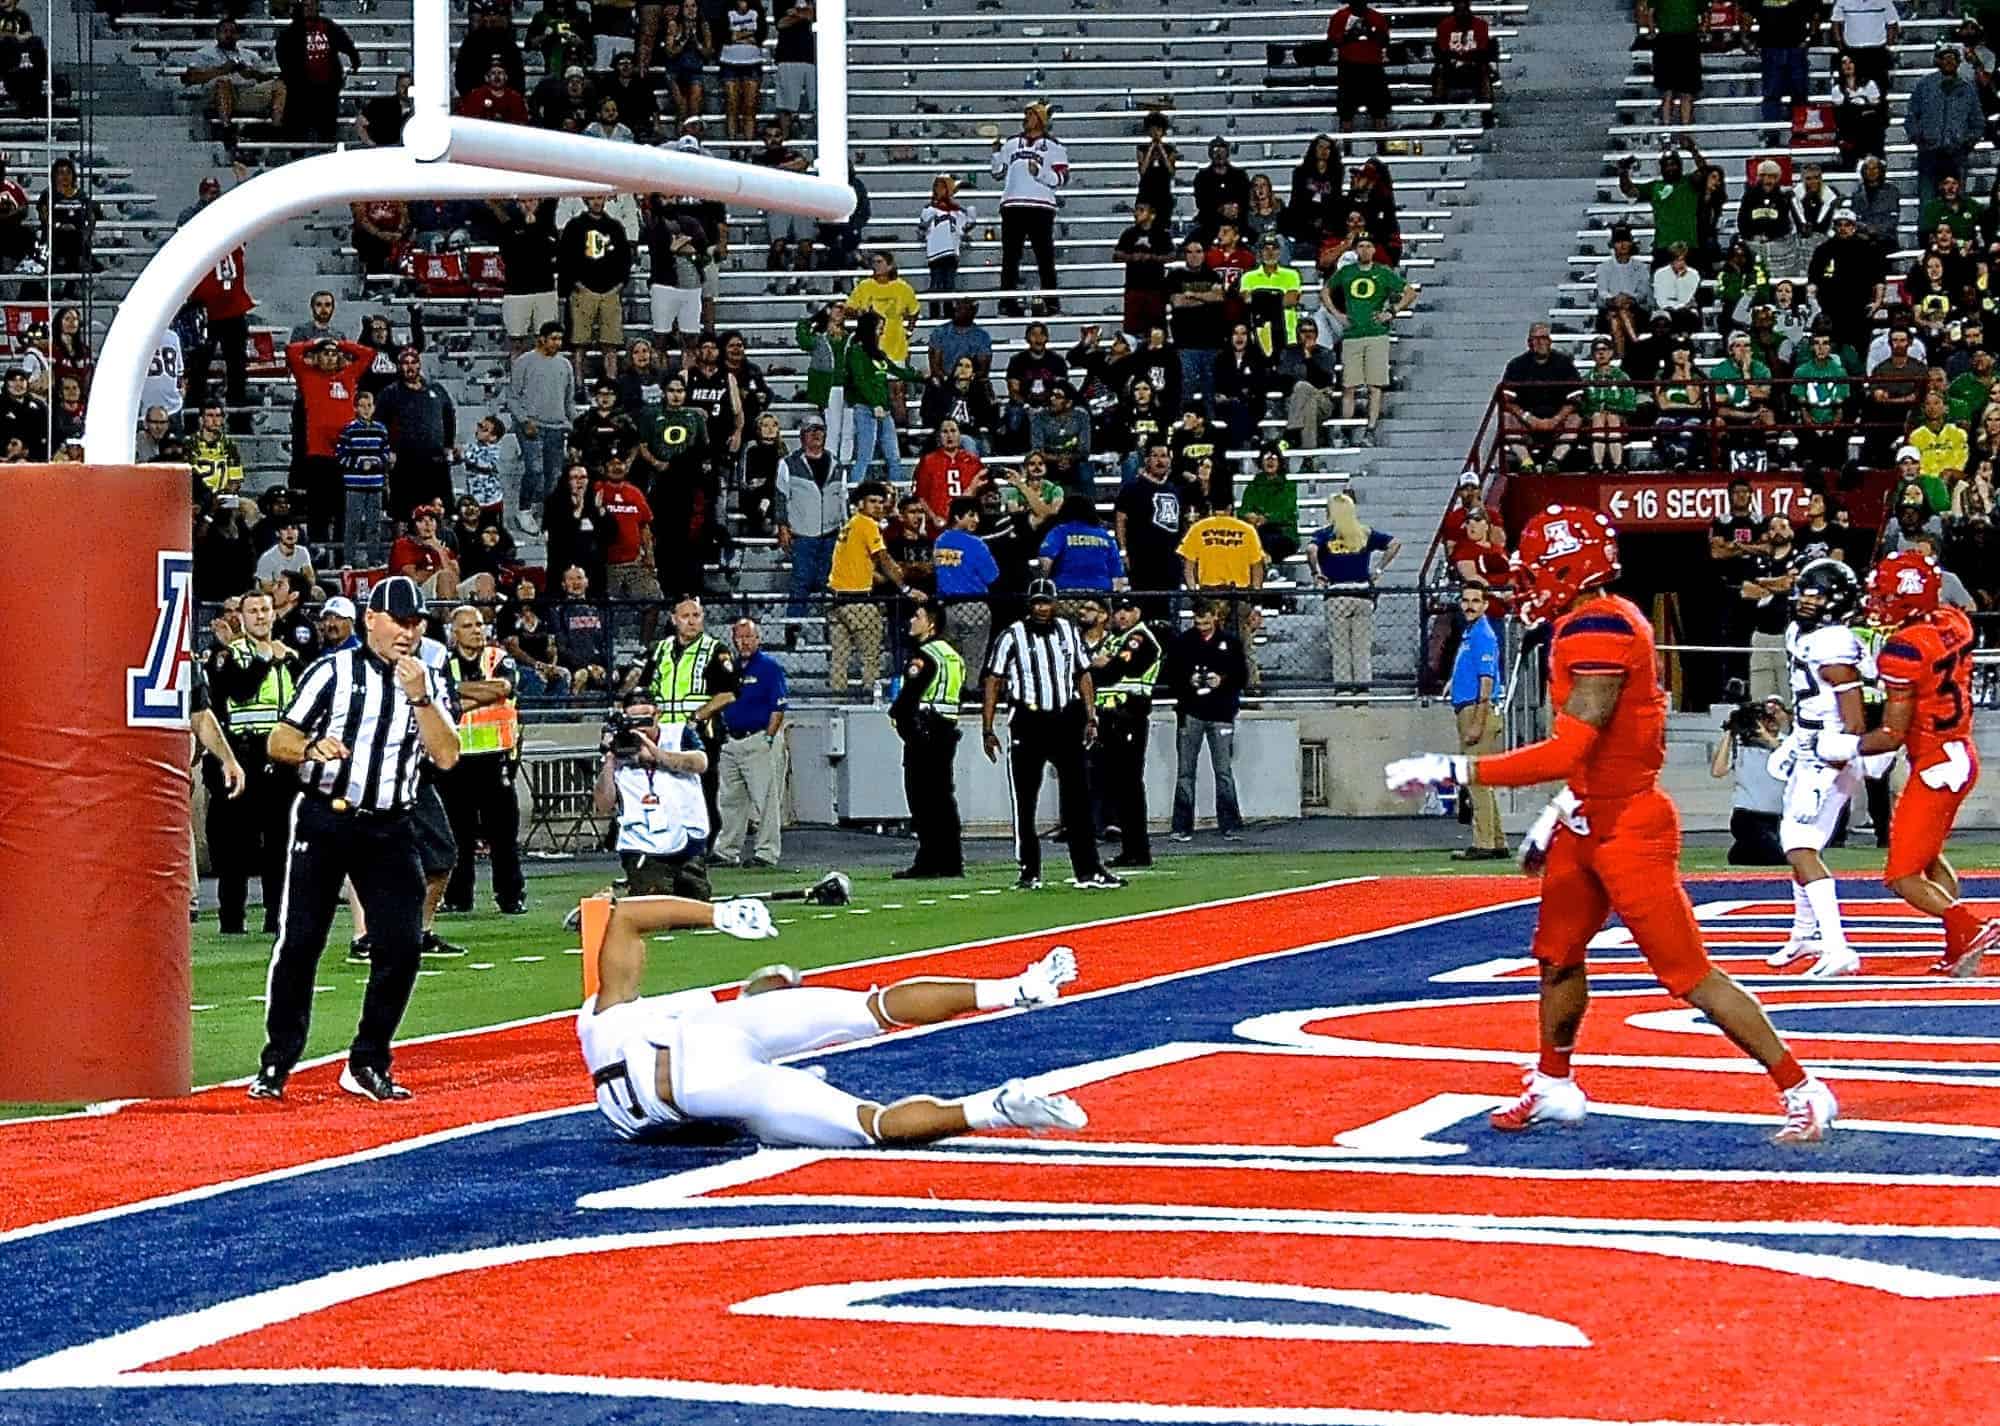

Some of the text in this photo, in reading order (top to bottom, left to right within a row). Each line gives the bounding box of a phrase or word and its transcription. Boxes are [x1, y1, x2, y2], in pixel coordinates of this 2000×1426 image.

[1350, 277, 1375, 298] O
[692, 387, 727, 401] HEAT
[711, 403, 721, 417] 3
[663, 426, 687, 445] O
[1633, 487, 1794, 519] 16 SECTIN 17
